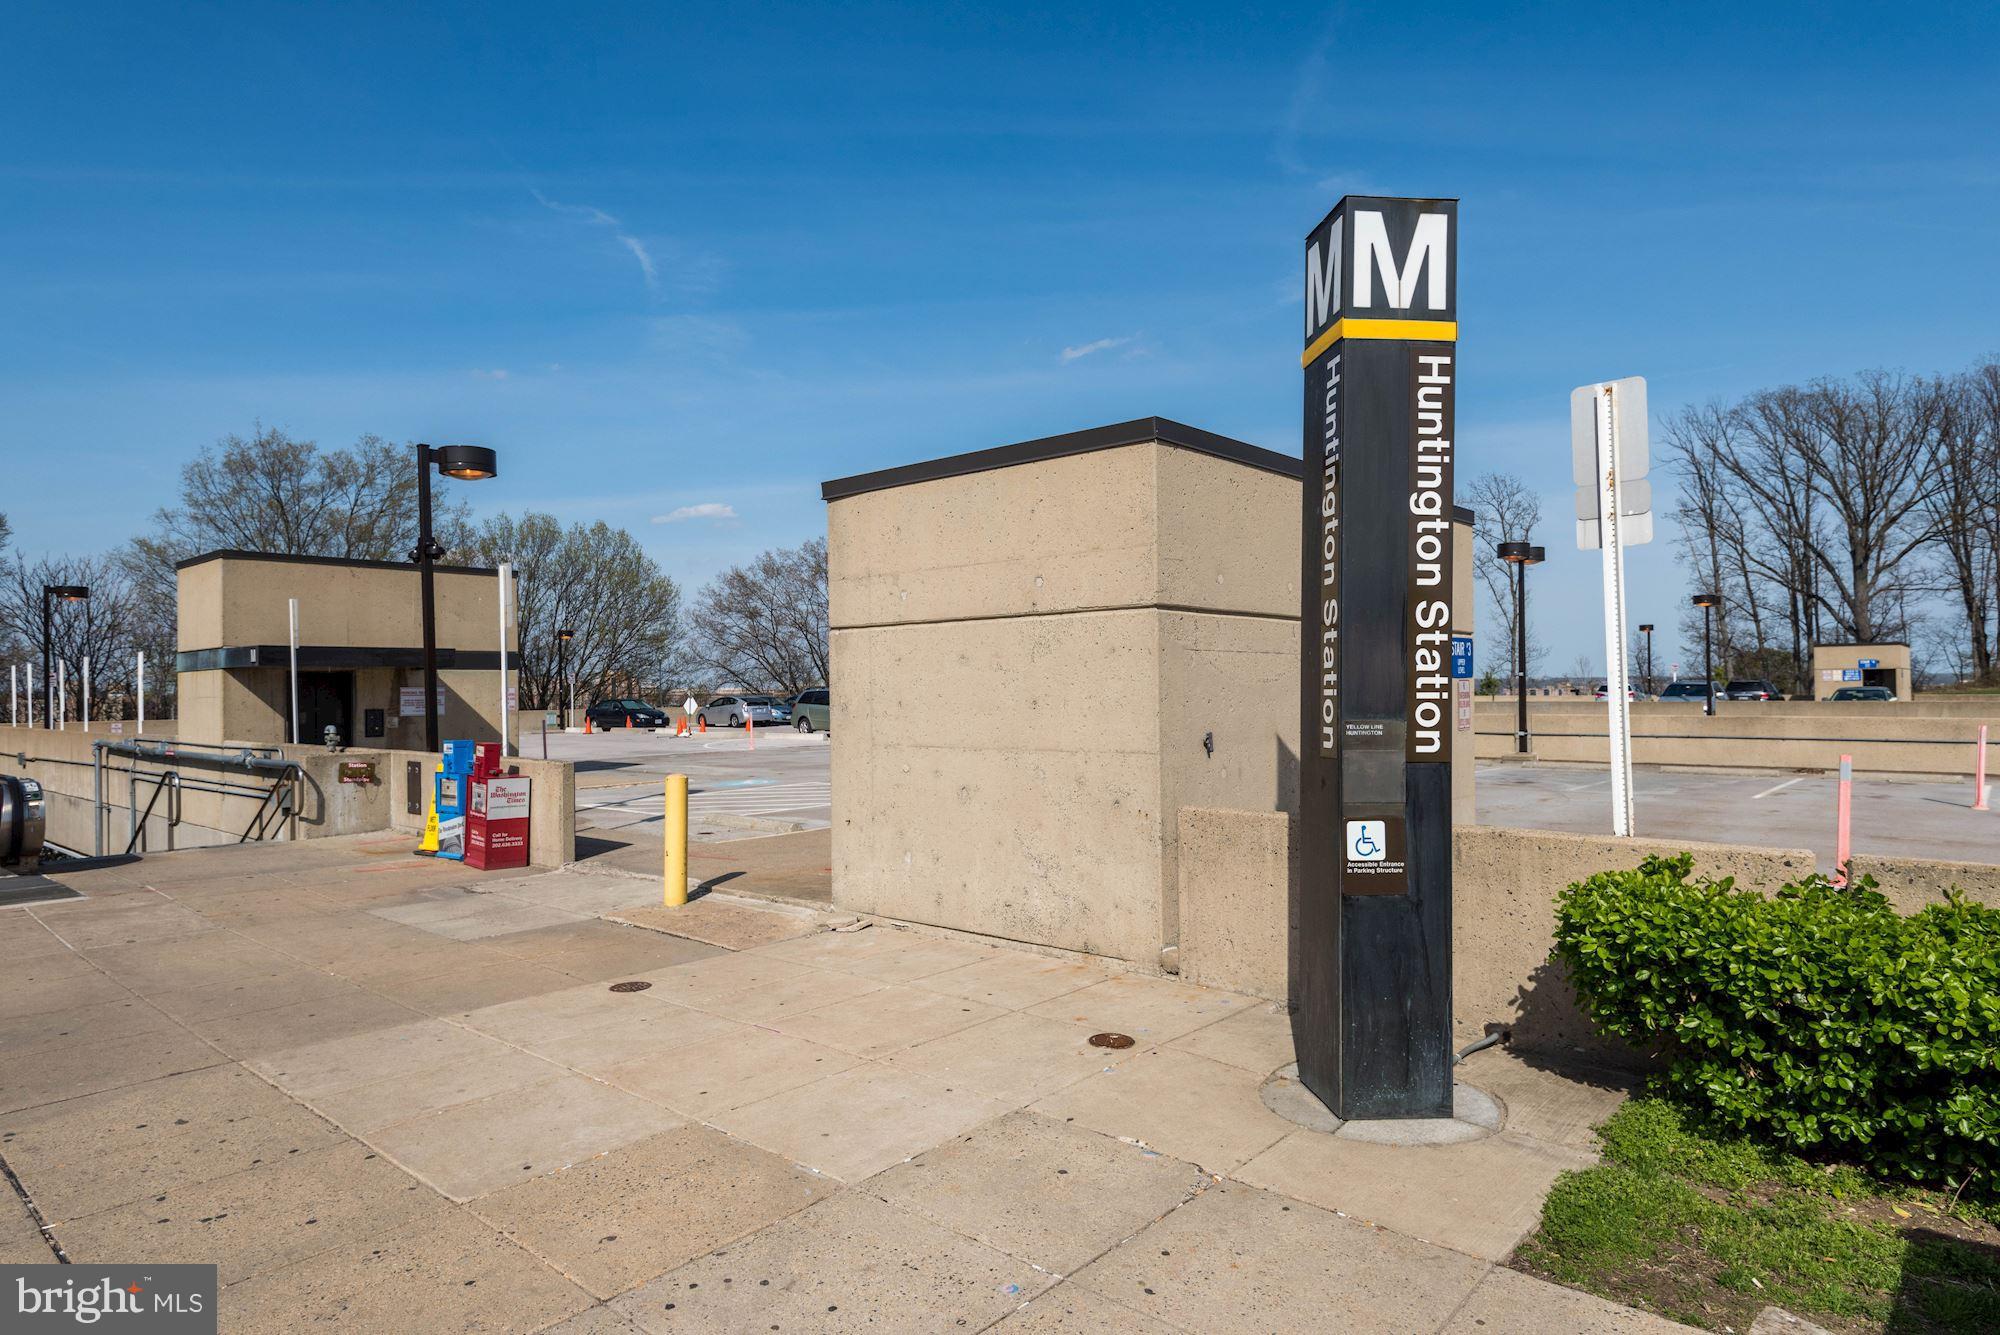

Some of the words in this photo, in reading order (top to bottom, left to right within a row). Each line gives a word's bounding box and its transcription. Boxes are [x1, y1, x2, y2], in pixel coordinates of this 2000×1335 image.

[1307, 215, 1343, 339] M
[1353, 210, 1448, 310] M
[1322, 354, 1341, 586] Huntington
[1409, 355, 1451, 586] Huntington
[1322, 598, 1338, 749] Station
[1414, 600, 1450, 753] Station
